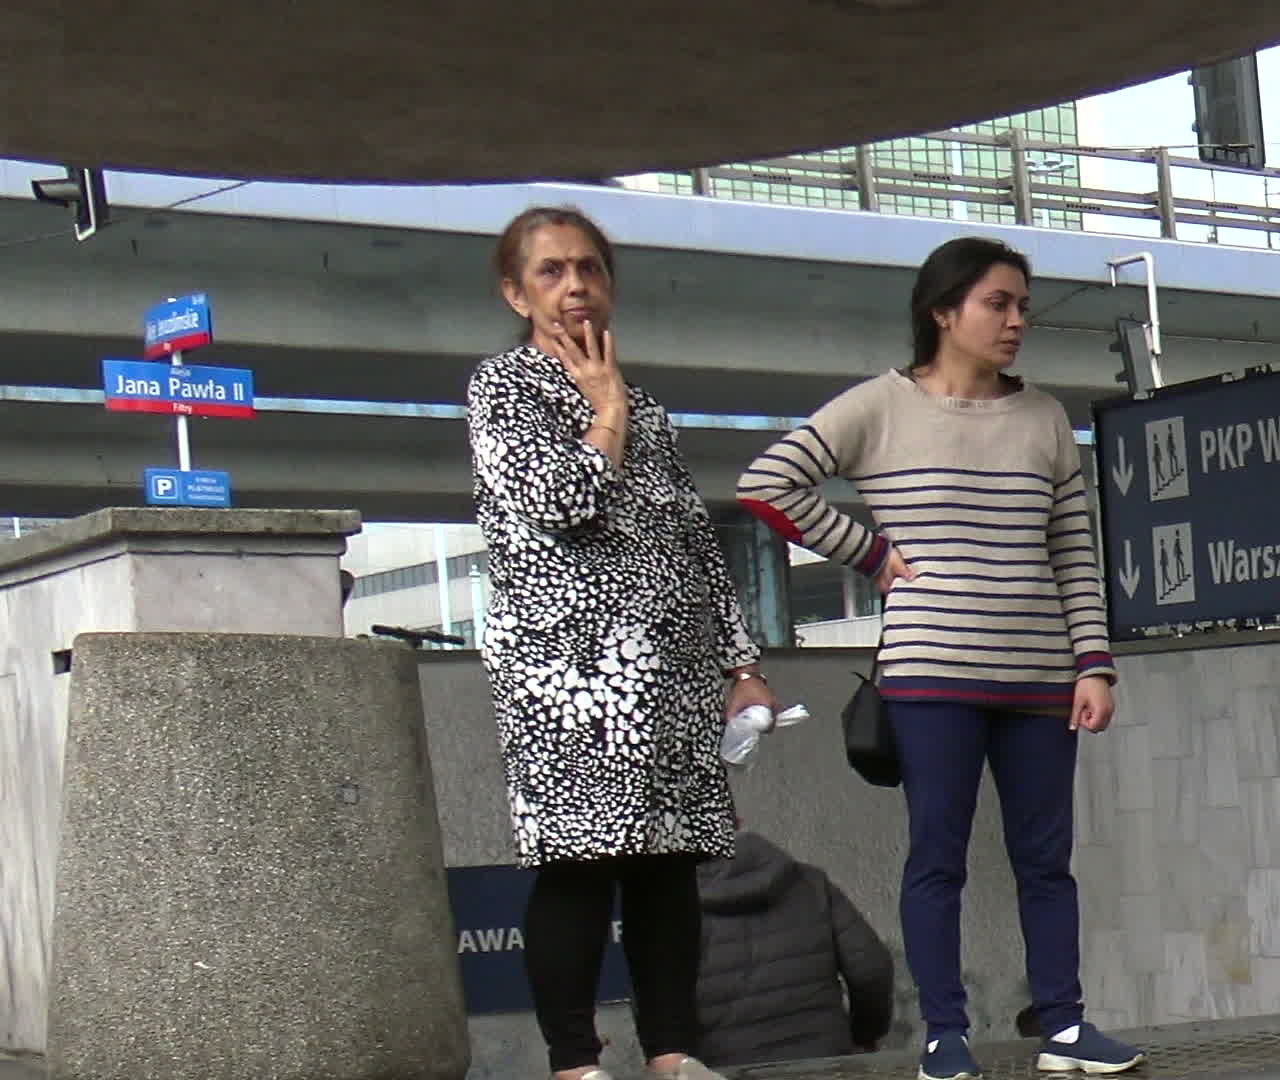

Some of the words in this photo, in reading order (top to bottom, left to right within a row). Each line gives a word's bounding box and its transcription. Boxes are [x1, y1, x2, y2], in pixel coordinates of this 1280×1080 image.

[116, 375, 160, 396] Jana
[169, 377, 226, 400] Pawła
[233, 383, 244, 401] II
[1200, 423, 1253, 473] PKP
[456, 927, 525, 954] AWA
